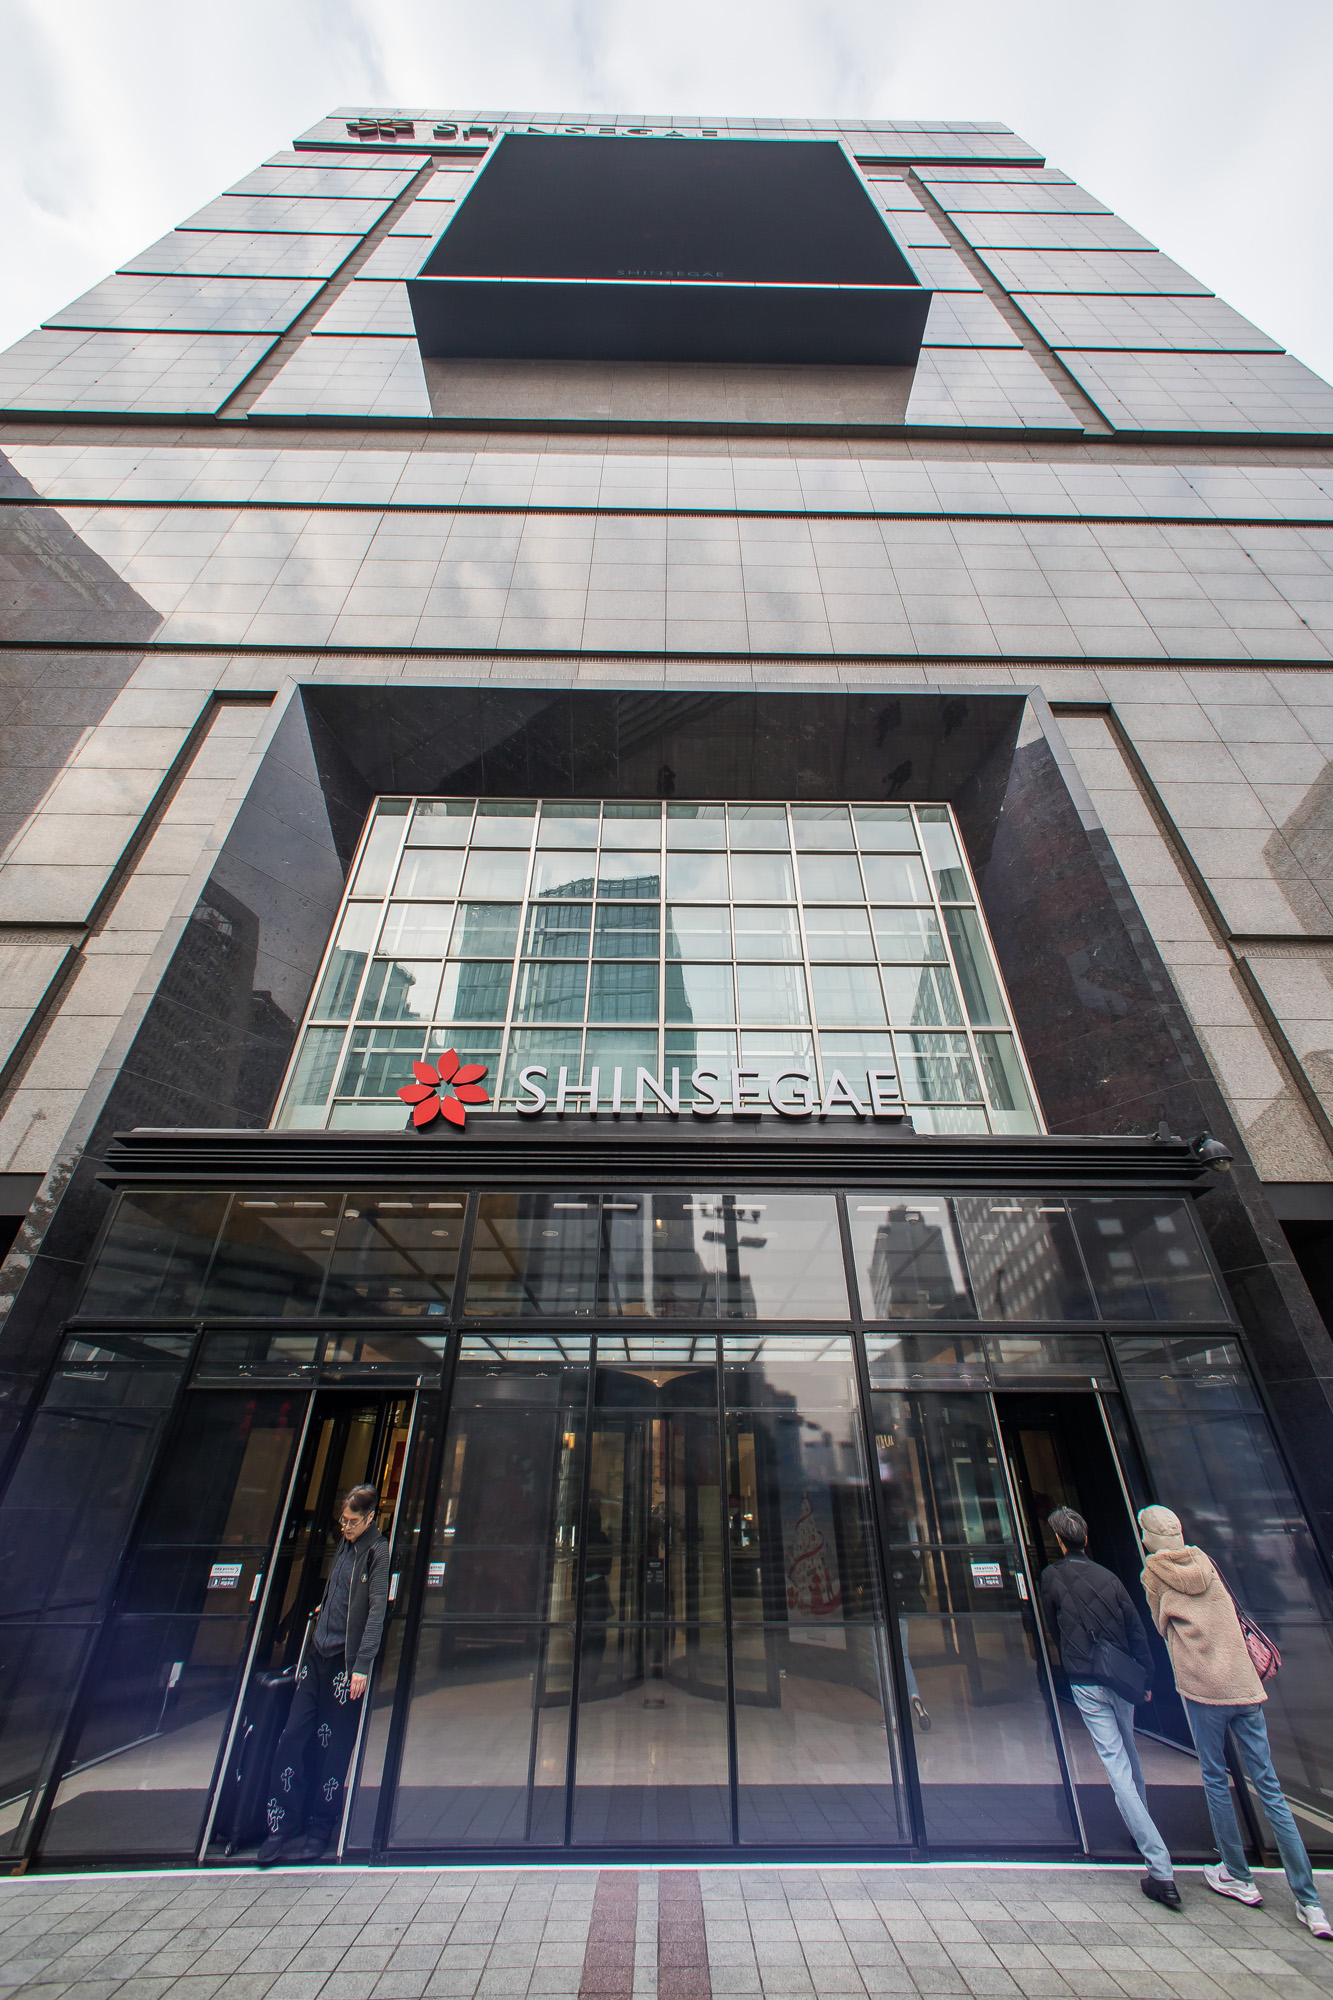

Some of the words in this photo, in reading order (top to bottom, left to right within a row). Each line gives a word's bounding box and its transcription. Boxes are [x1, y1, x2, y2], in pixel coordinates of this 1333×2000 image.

[432, 122, 719, 141] SHINSEGAE
[616, 269, 725, 278] SHINSEGAE
[515, 1065, 906, 1119] SHINSEGAE
